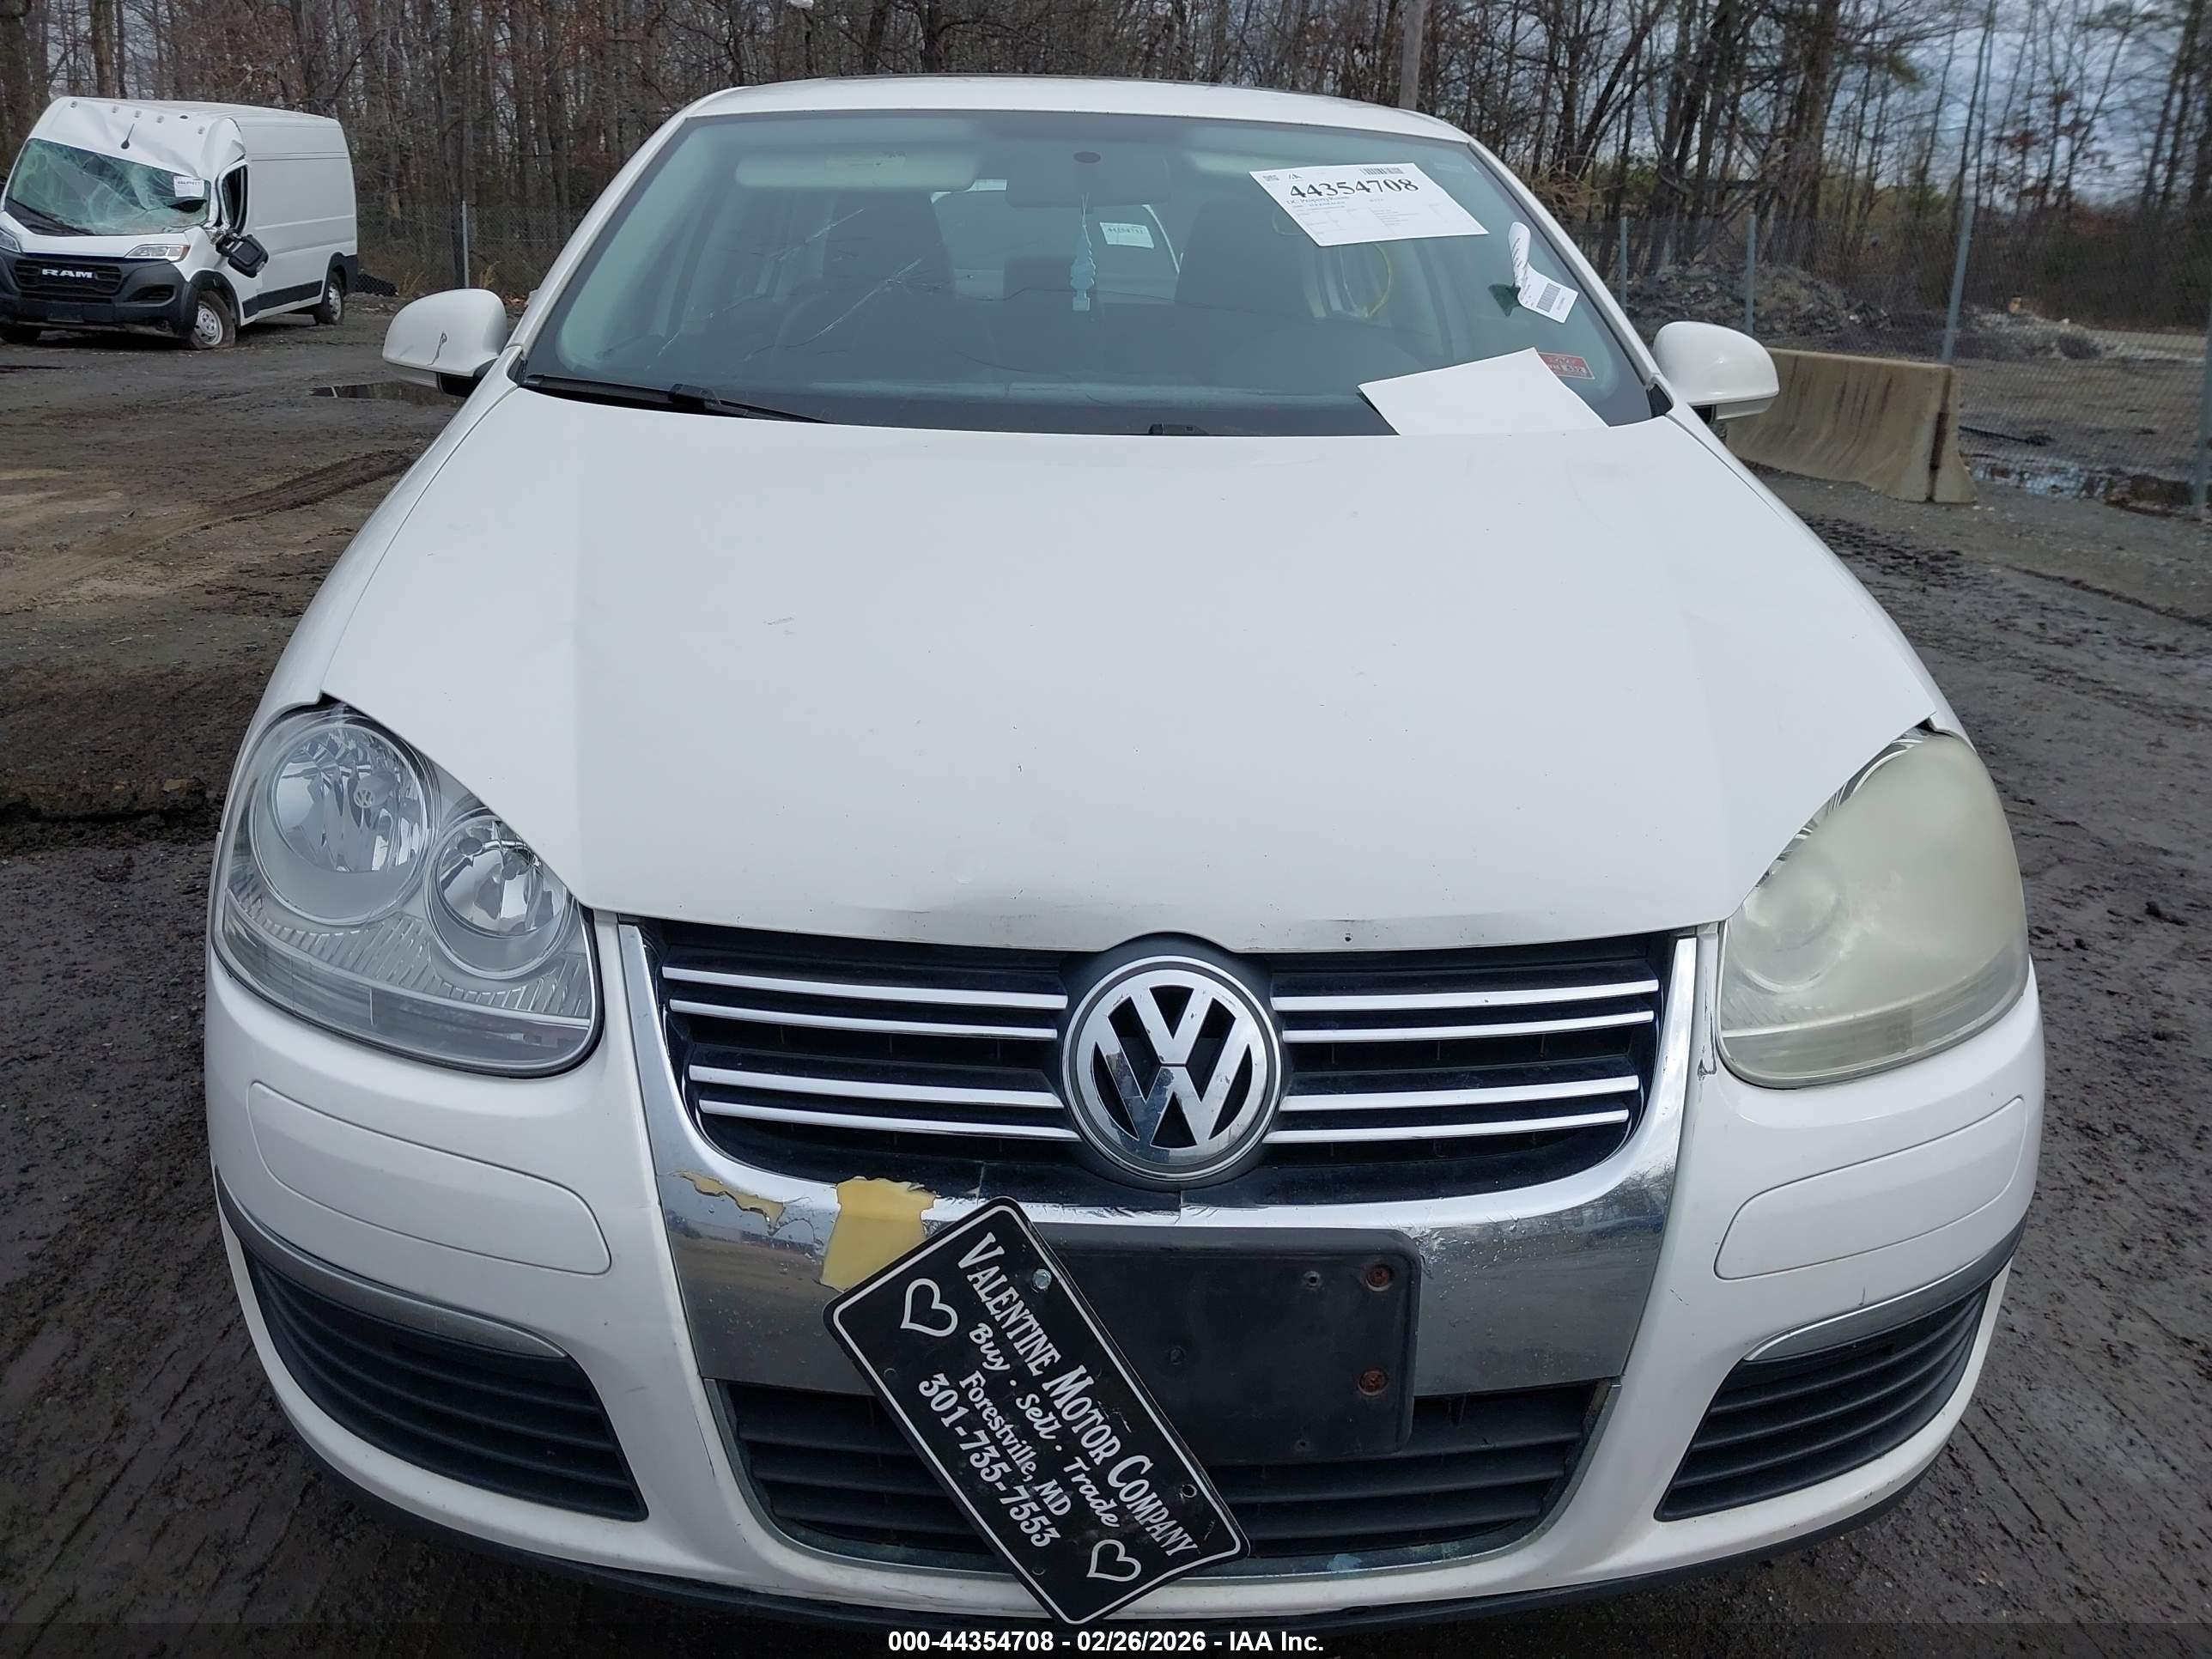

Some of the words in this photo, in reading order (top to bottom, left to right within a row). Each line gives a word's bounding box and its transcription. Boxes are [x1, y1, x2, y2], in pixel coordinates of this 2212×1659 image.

[1290, 179, 1419, 198] 44354708
[41, 269, 93, 278] RAM
[918, 1373, 1061, 1547] 301-735-7553
[957, 1231, 1061, 1376] VALENTINE
[1042, 1364, 1121, 1466] MOTOR
[1108, 1455, 1198, 1556] COMPANY
[959, 1370, 1037, 1482] Forestville,
[1033, 1479, 1072, 1516] MD
[969, 1322, 1011, 1371] Buy
[1015, 1393, 1062, 1440] Sell
[1063, 1456, 1121, 1528] Trade
